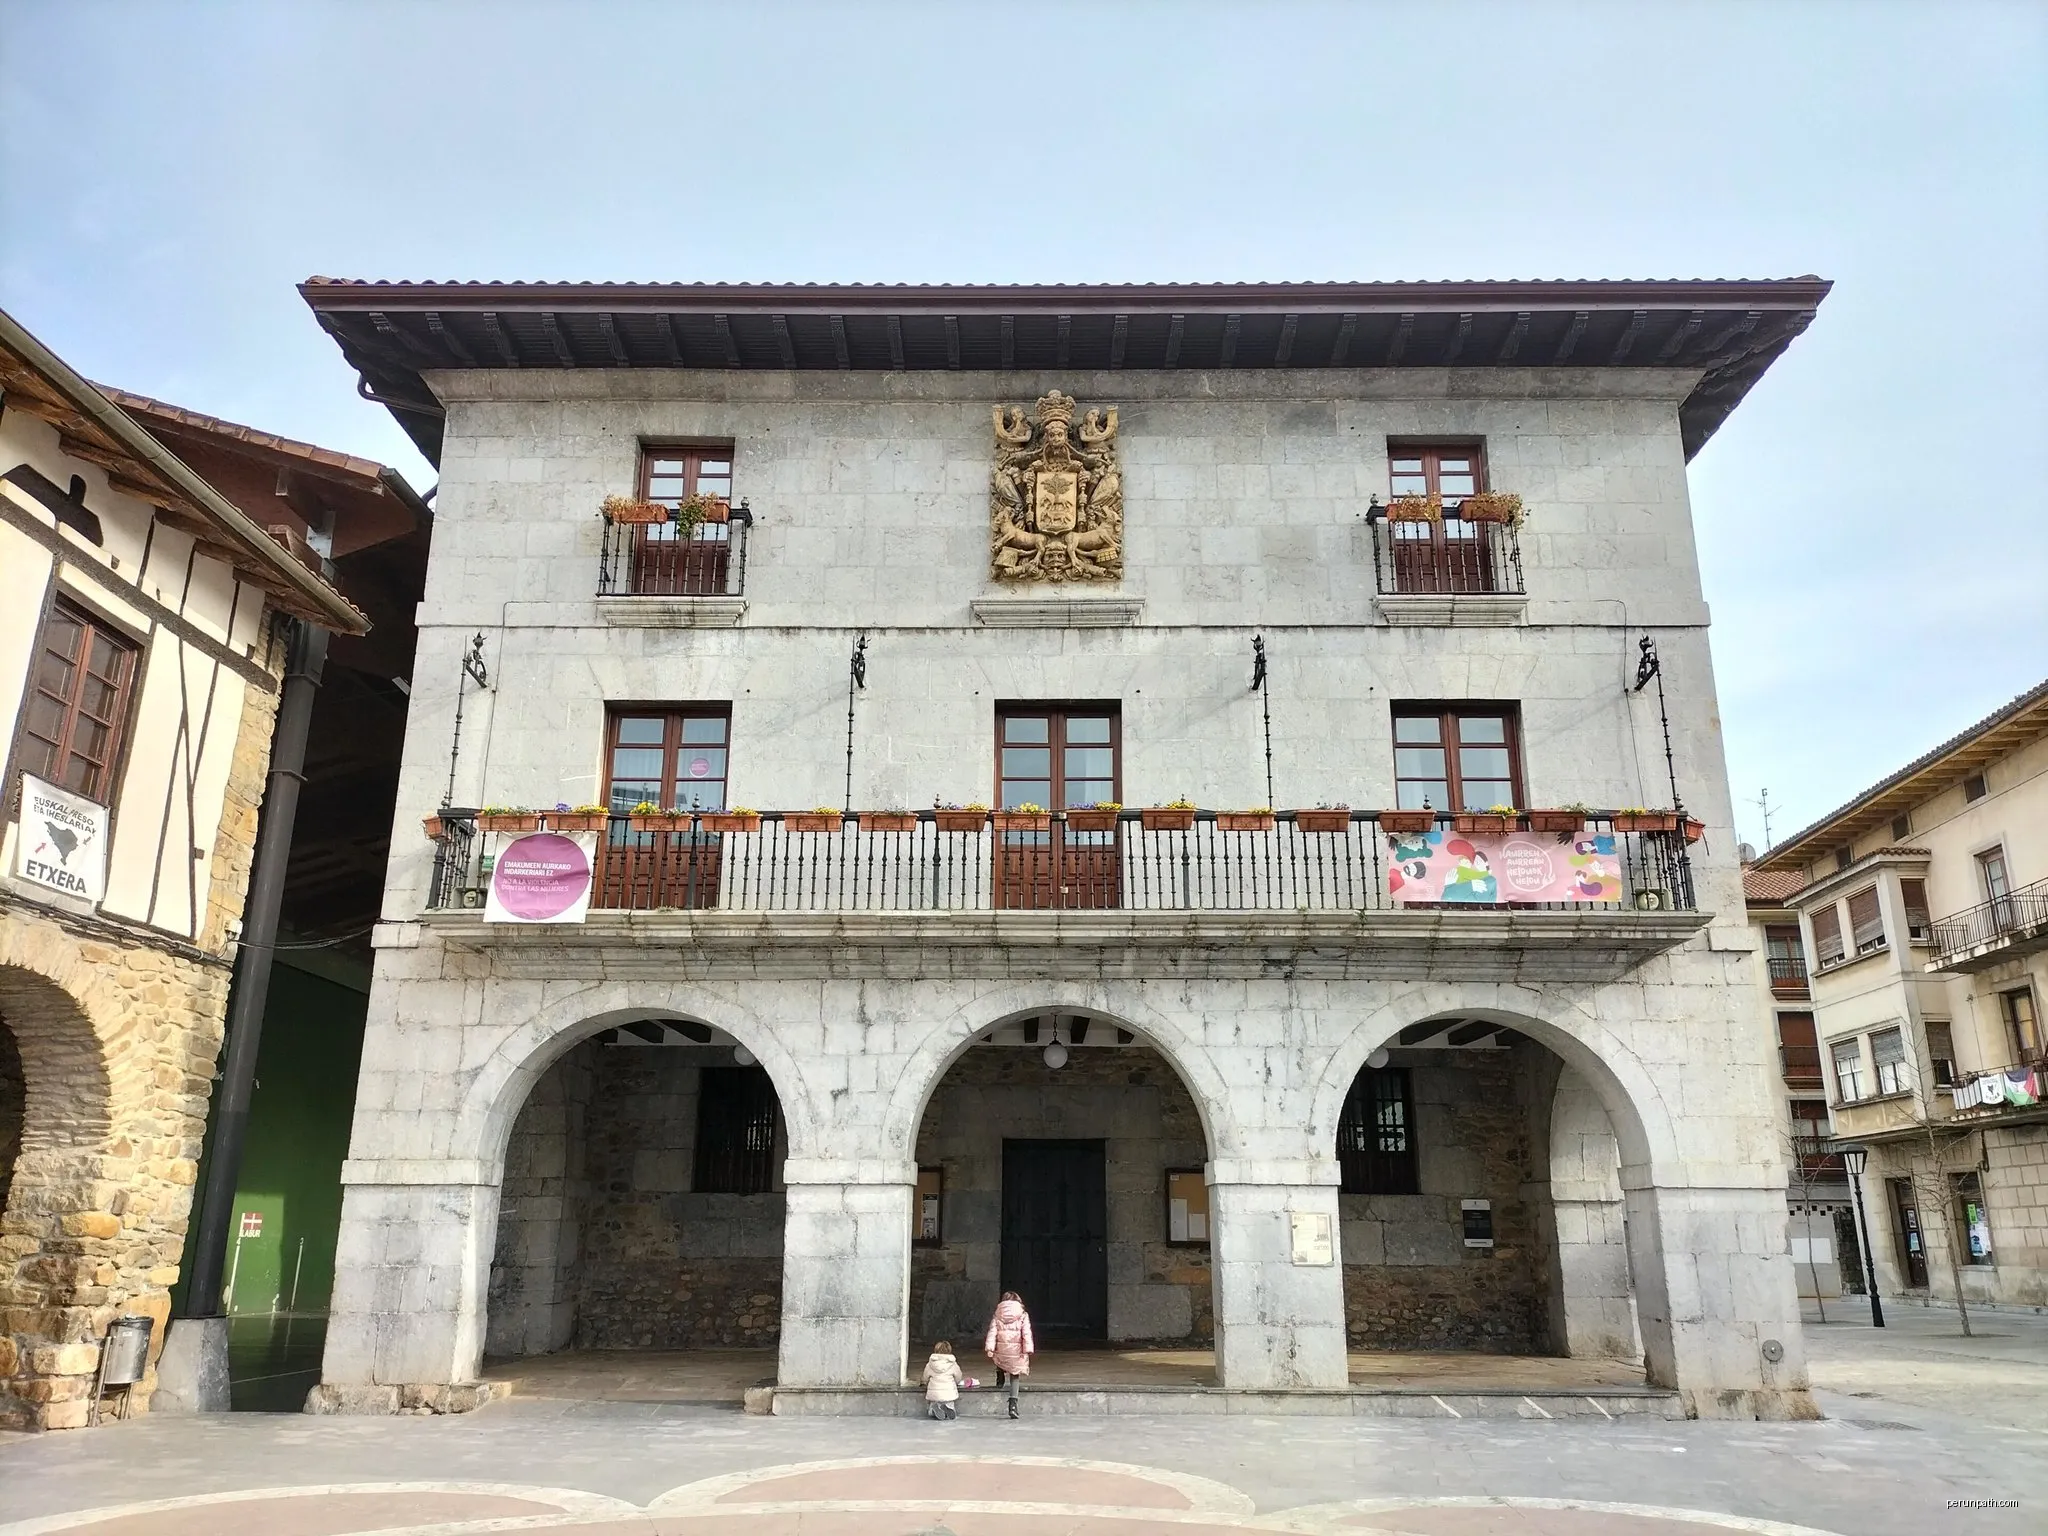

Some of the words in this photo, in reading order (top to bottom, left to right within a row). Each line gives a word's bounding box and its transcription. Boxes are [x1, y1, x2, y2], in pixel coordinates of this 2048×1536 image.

[34, 796, 69, 815] EUSKAL
[504, 861, 541, 869] EMAKUMEEN
[26, 859, 87, 894] ETXERA
